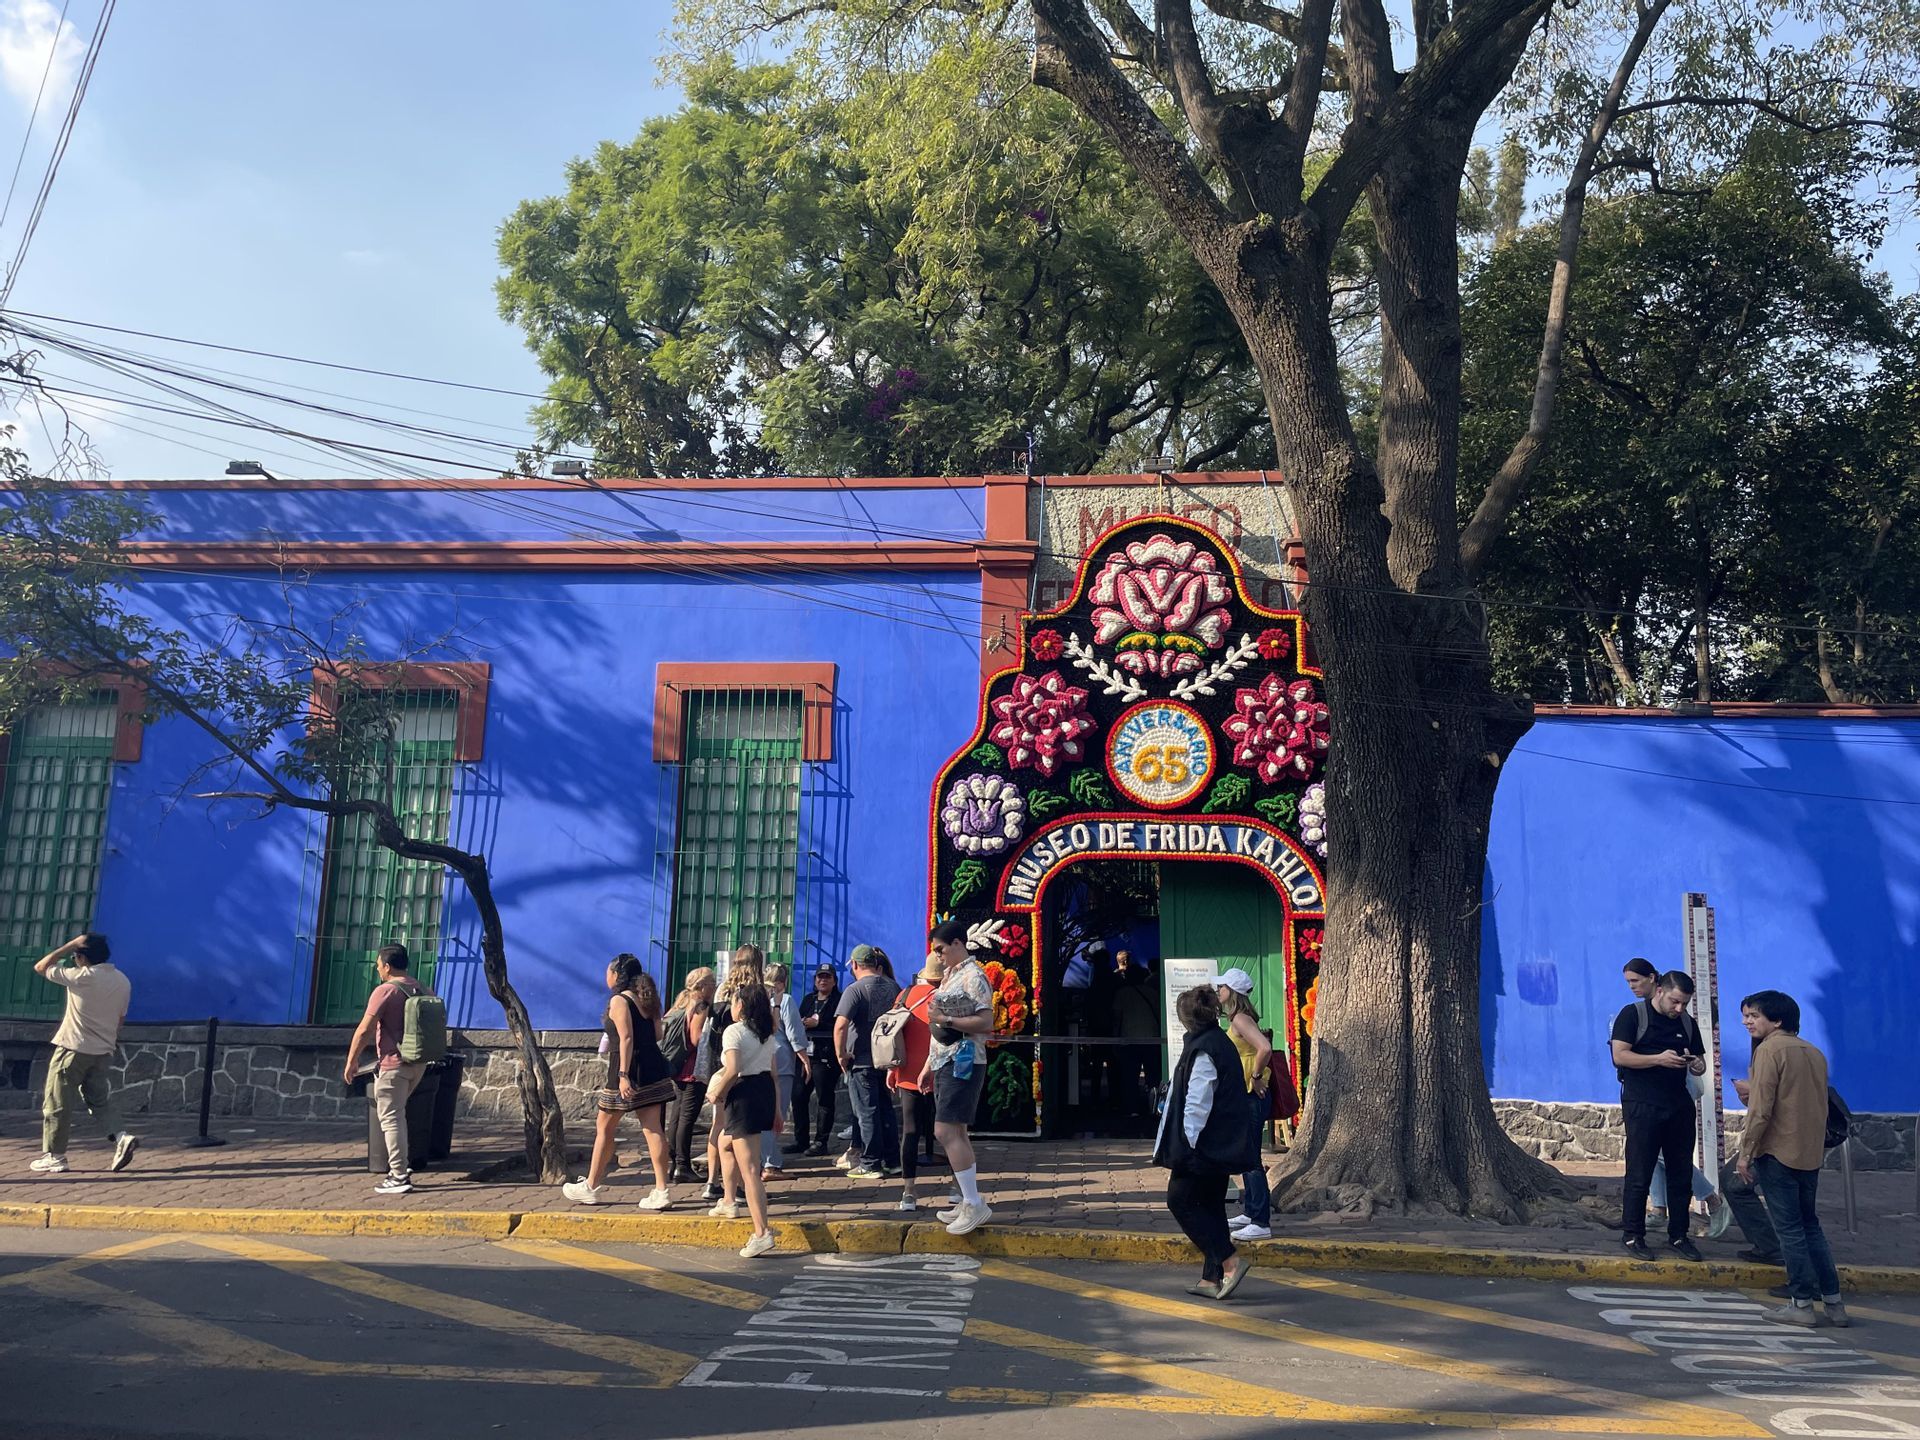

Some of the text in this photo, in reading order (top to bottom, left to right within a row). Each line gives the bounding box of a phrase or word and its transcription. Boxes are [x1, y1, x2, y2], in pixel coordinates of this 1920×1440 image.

[1115, 709, 1208, 776] ANIVERSARIO
[1134, 744, 1188, 783] 65
[1008, 822, 1319, 906] MUSEO DE FRIDA KAHLO
